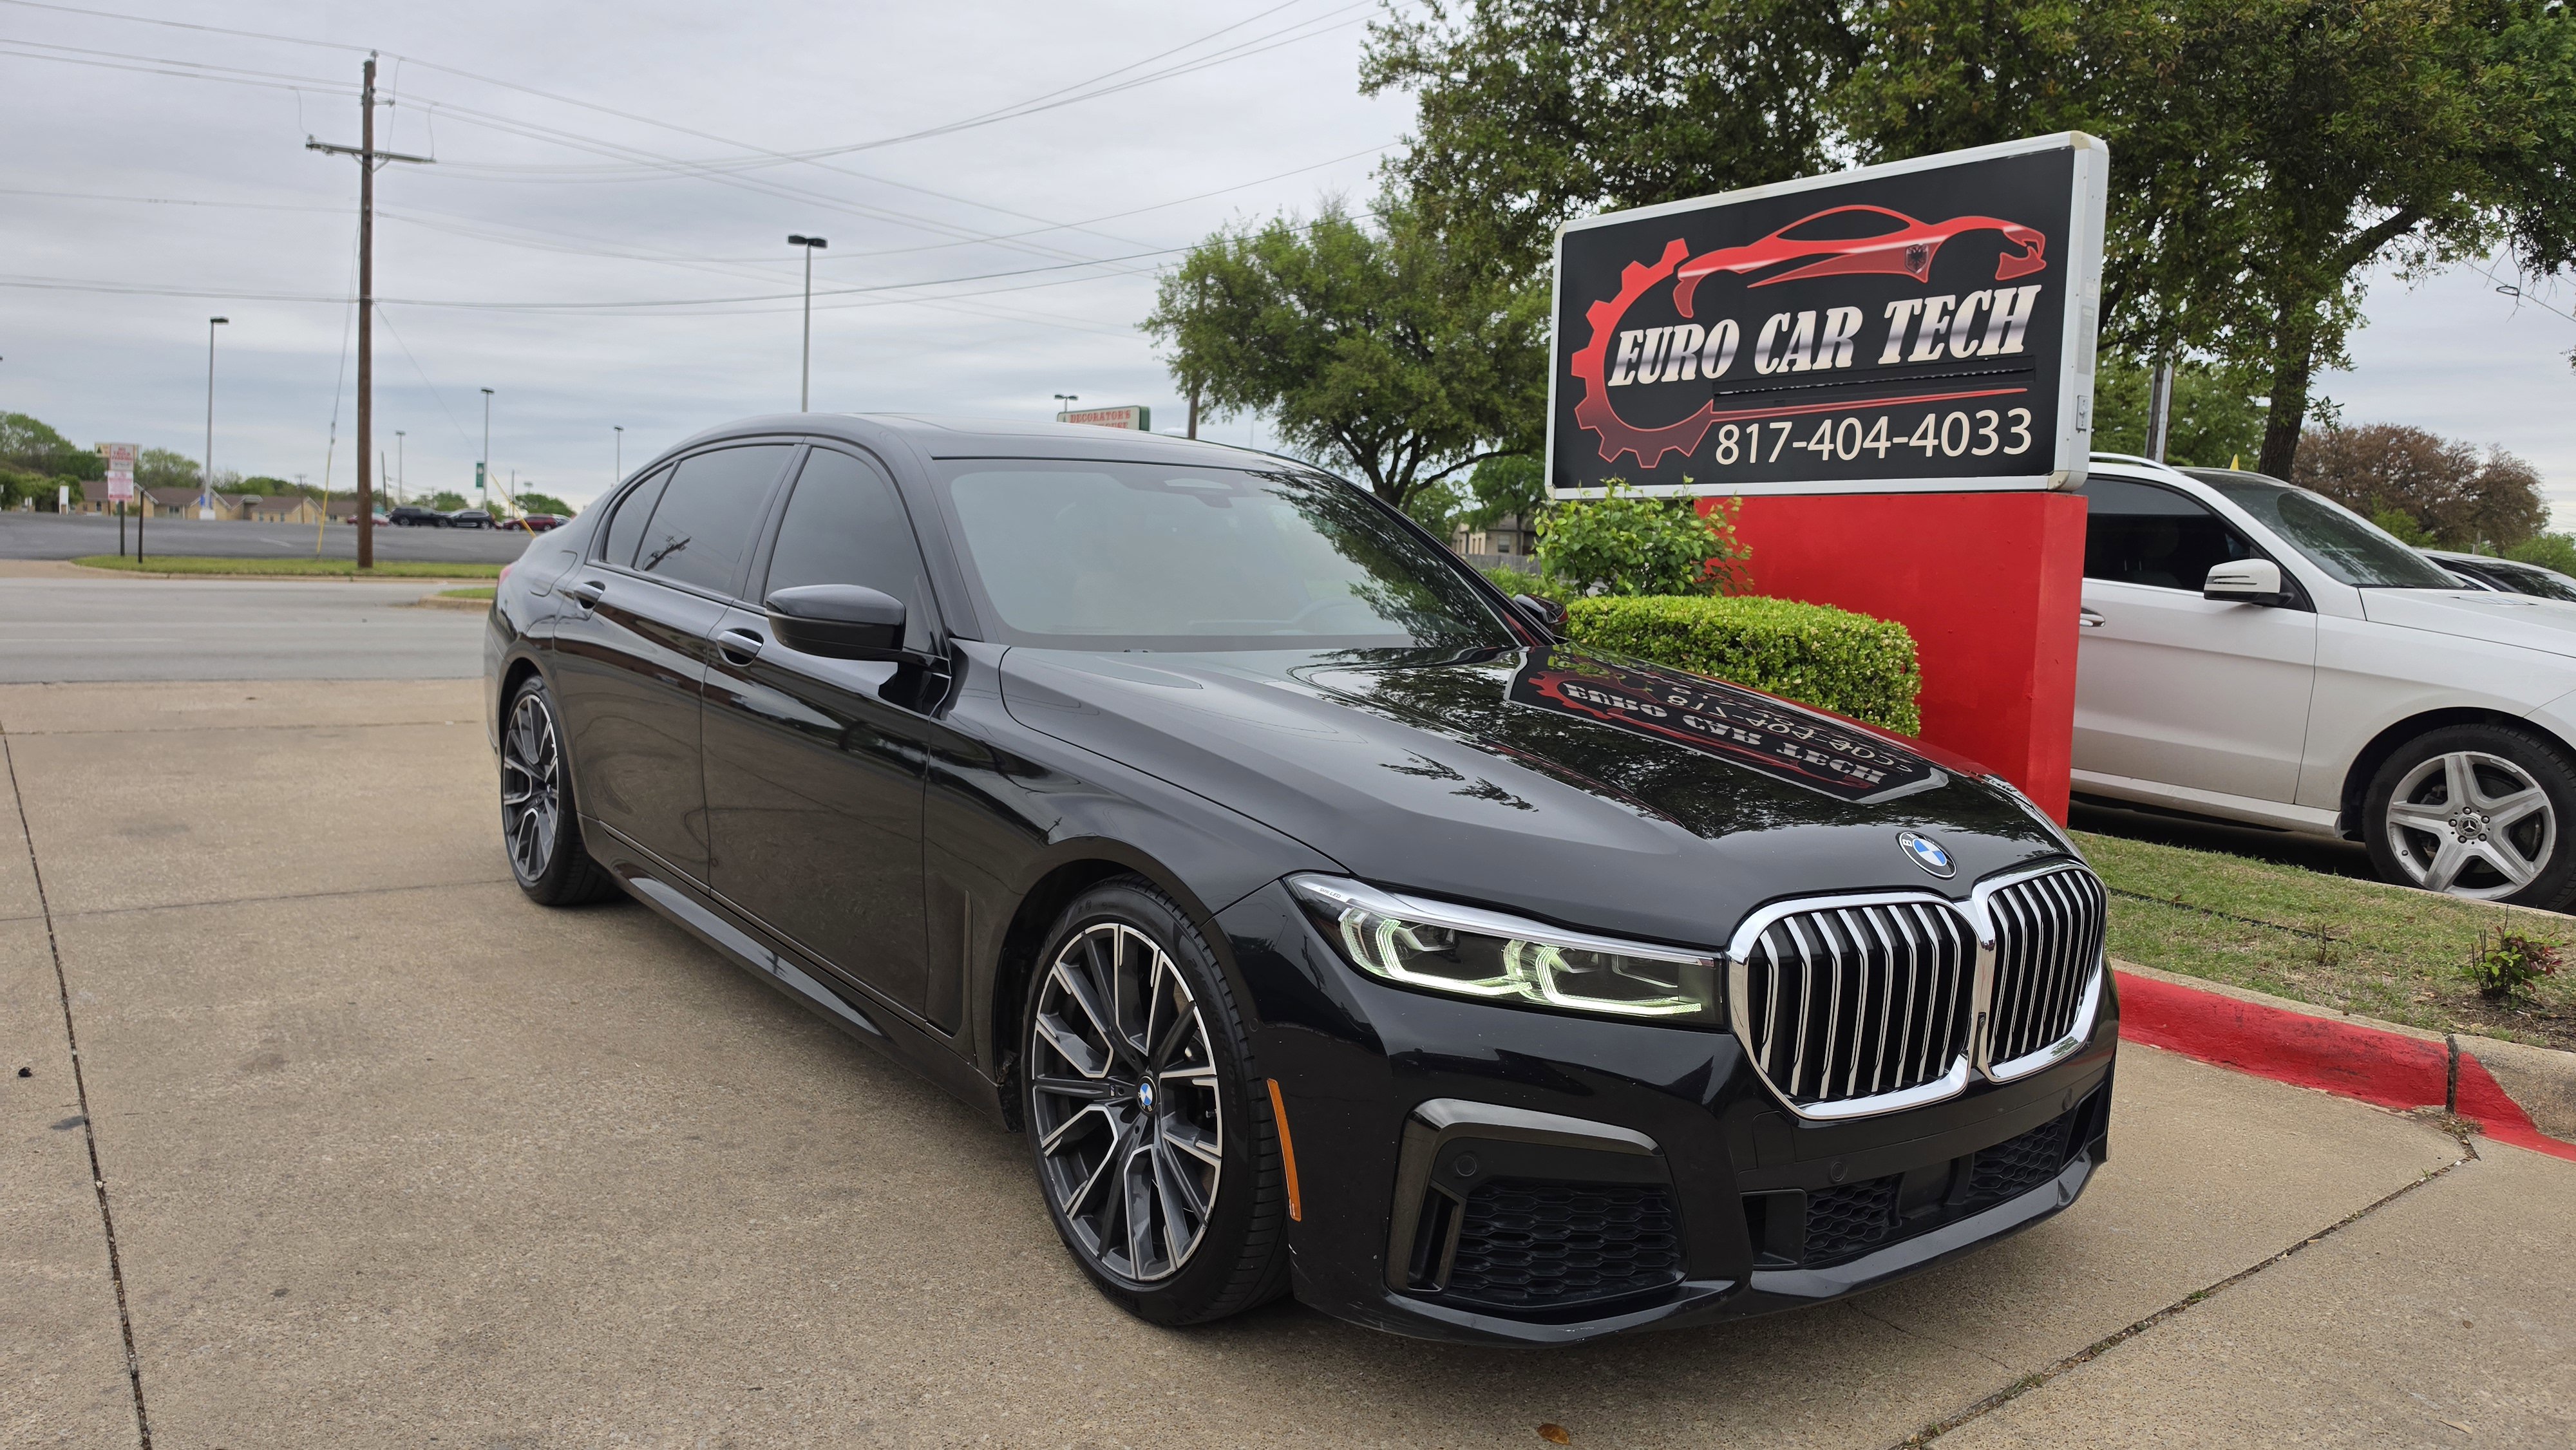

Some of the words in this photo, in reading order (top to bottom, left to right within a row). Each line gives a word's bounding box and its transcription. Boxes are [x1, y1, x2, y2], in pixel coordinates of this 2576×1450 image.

[1607, 319, 1740, 386] EURO
[1755, 306, 1864, 375] CAR
[1879, 285, 2043, 365] TECH
[1070, 410, 1131, 423] DECORATOR'S
[1716, 408, 2032, 466] 817-404-4033
